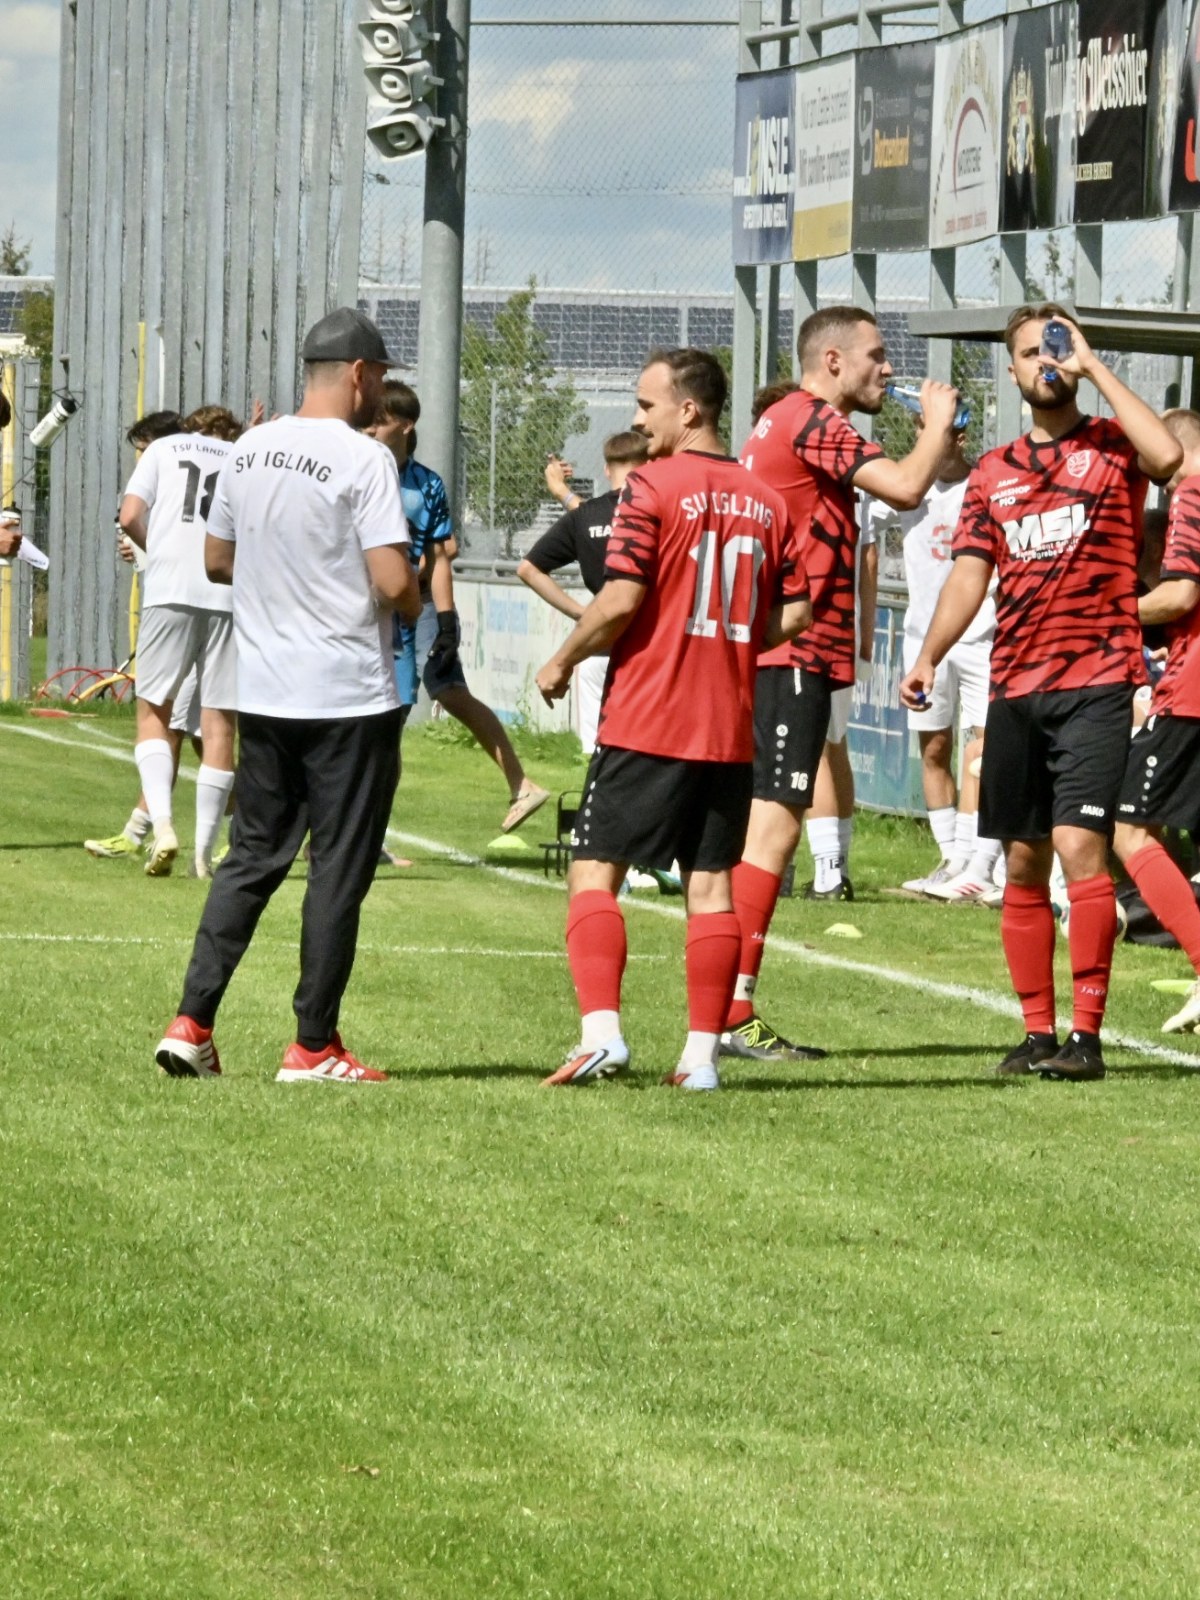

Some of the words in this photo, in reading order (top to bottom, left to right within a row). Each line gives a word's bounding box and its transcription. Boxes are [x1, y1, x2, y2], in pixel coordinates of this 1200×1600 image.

[235, 452, 256, 473] SV
[264, 451, 332, 483] IGLING
[712, 493, 773, 529] IGLING
[688, 531, 766, 643] 10
[791, 772, 808, 791] 16
[1081, 804, 1105, 817] JAKO
